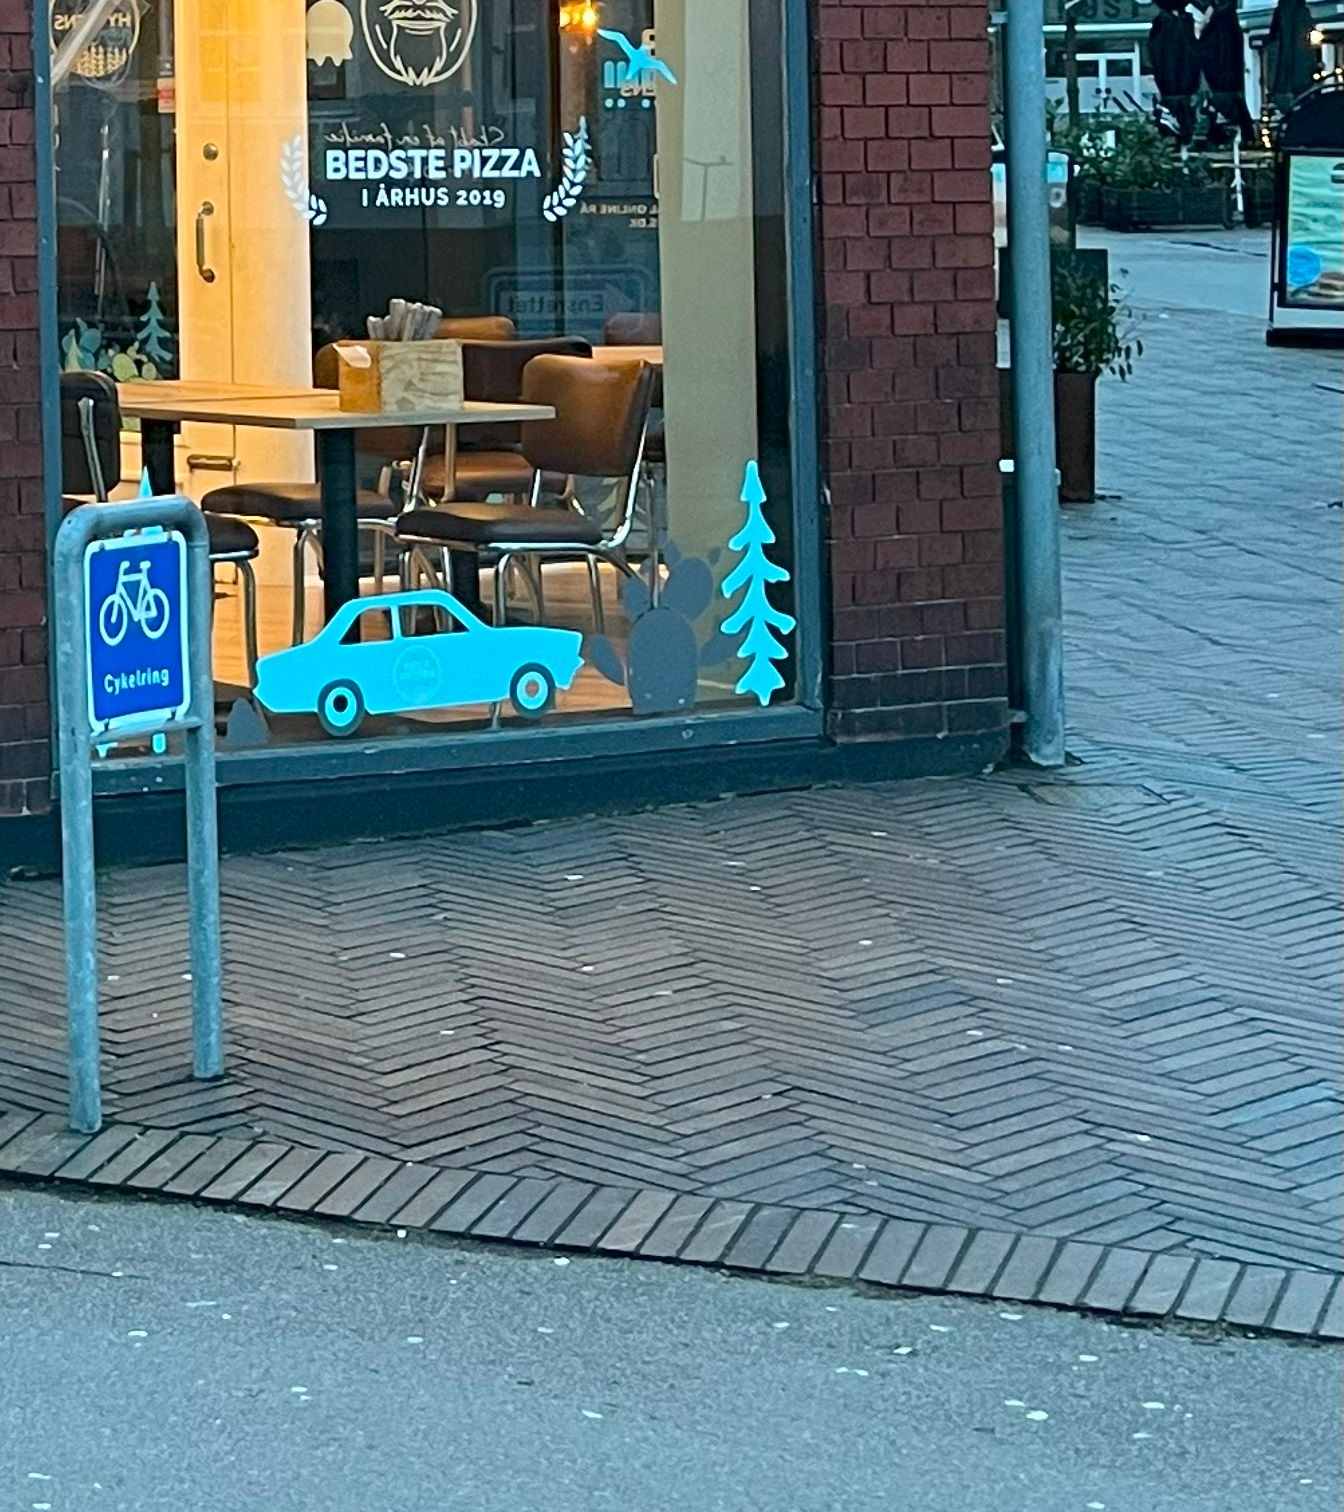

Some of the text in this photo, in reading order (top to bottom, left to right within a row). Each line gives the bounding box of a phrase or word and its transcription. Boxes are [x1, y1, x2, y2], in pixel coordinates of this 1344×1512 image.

[325, 148, 542, 181] BEDSTE PIZZA
[361, 183, 507, 209] I ÅRHUS 2019
[103, 667, 170, 695] Cykelring
